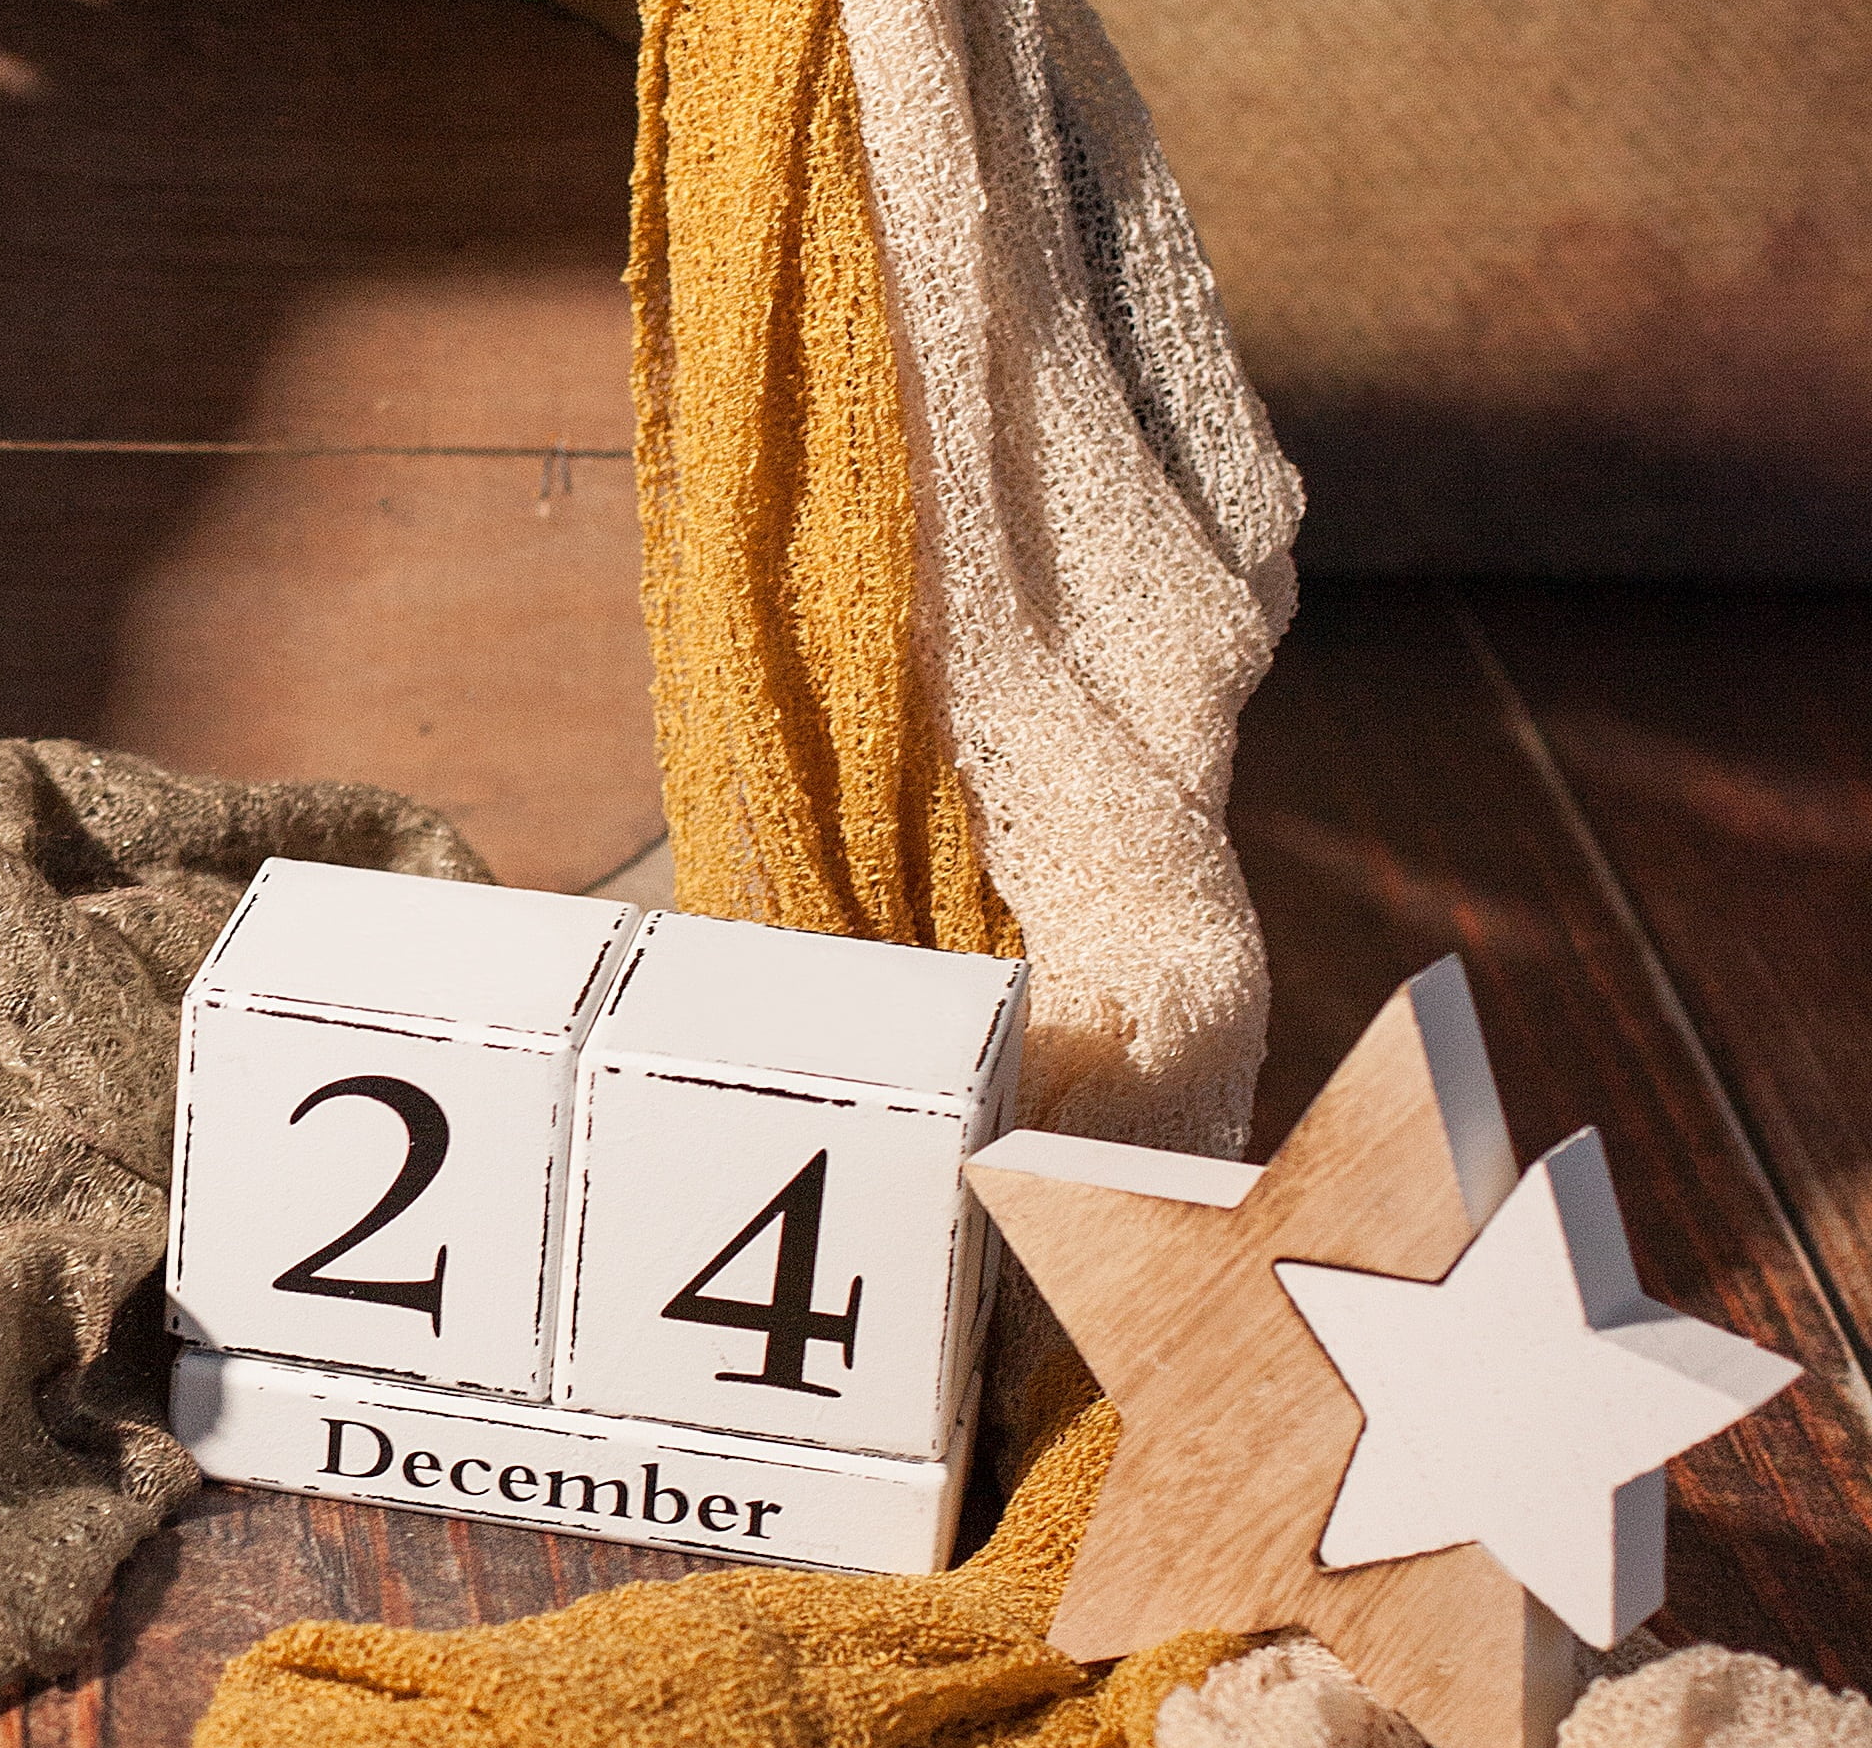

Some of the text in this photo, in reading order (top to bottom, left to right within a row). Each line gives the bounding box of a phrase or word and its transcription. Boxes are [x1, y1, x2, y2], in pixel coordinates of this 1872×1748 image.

[271, 1074, 864, 1399] 2 4
[315, 1416, 784, 1541] December
